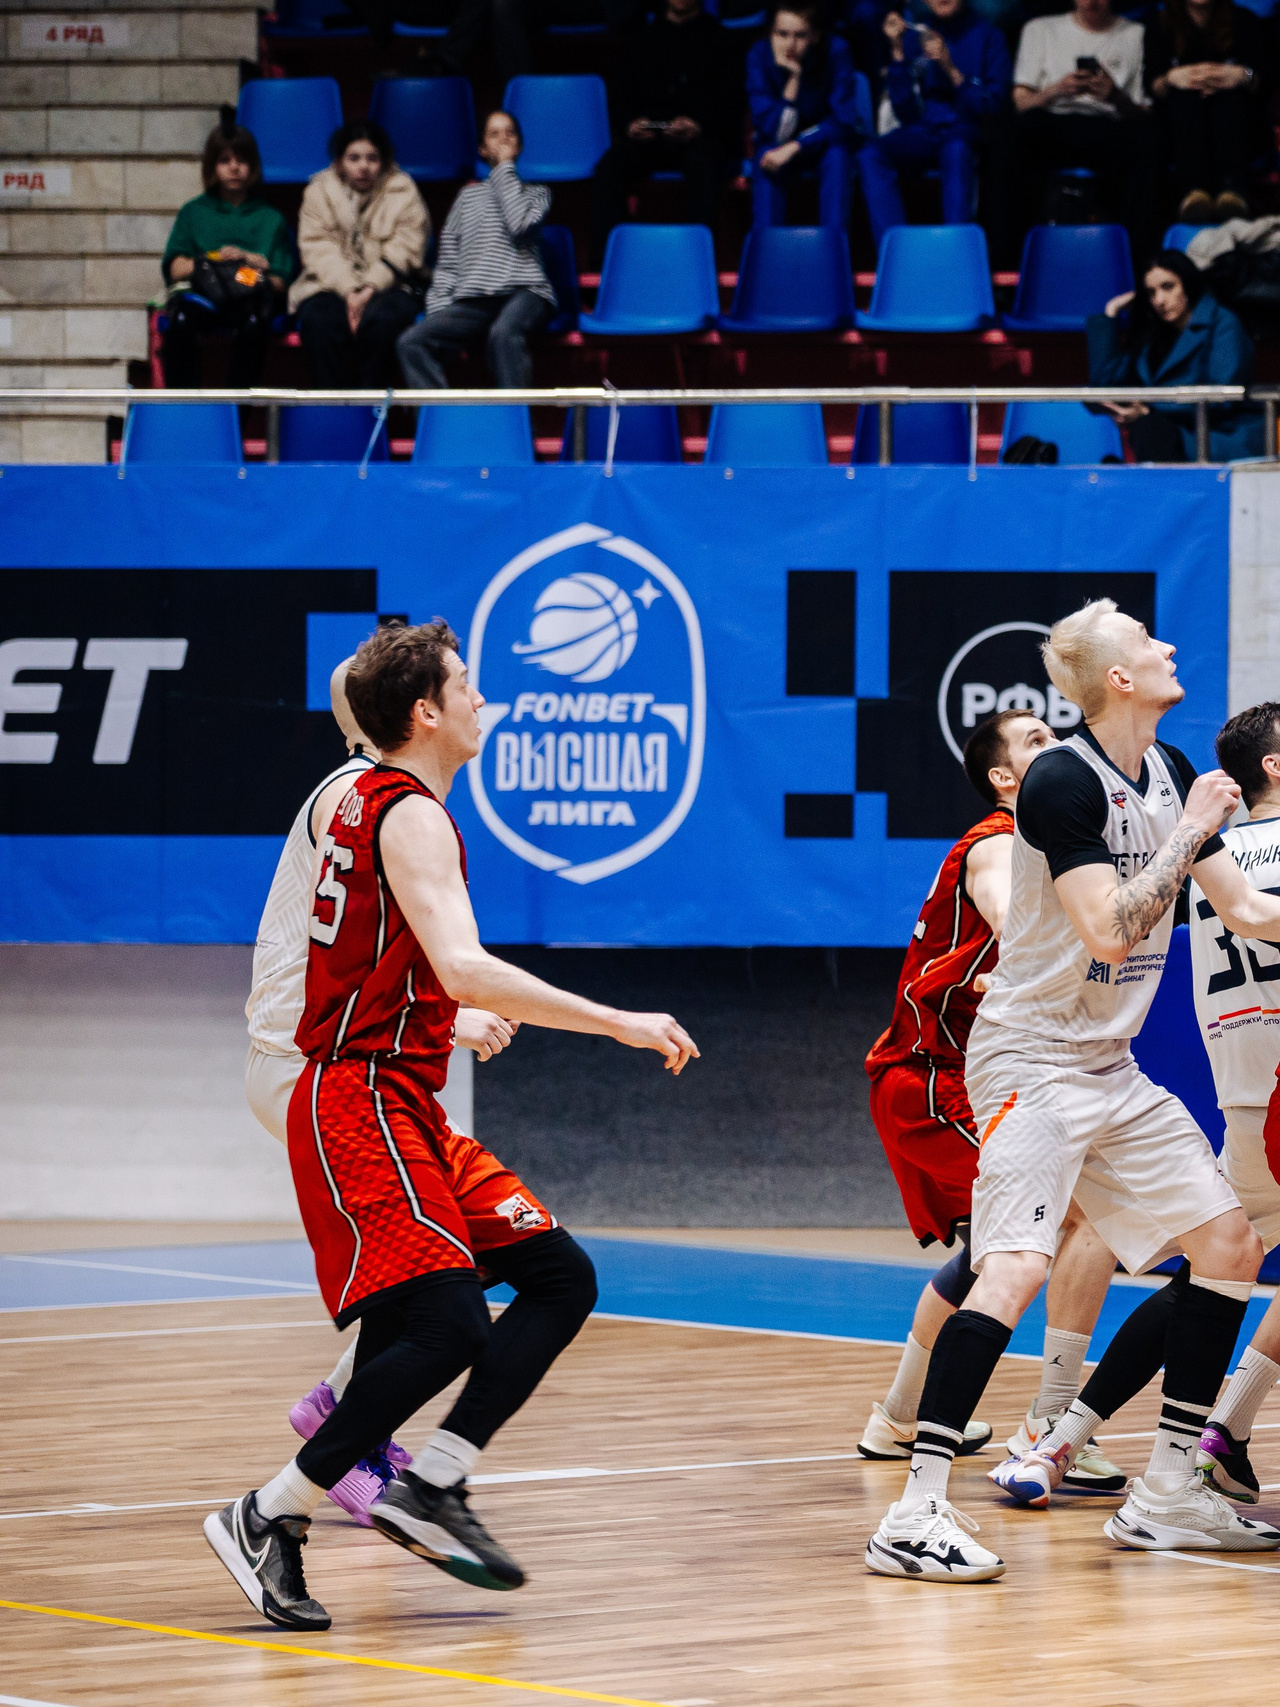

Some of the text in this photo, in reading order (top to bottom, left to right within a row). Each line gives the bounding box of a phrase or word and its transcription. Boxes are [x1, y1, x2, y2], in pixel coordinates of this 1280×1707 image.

[45, 26, 105, 45] 4 РЯД
[3, 172, 46, 191] РЯД
[511, 692, 655, 722] FONBET
[961, 682, 1084, 729] РФБ
[495, 731, 668, 792] ВЫСШАЯ
[527, 801, 636, 826] ЛИГА
[1221, 1015, 1263, 1032] ПОДДЕРЖКИ
